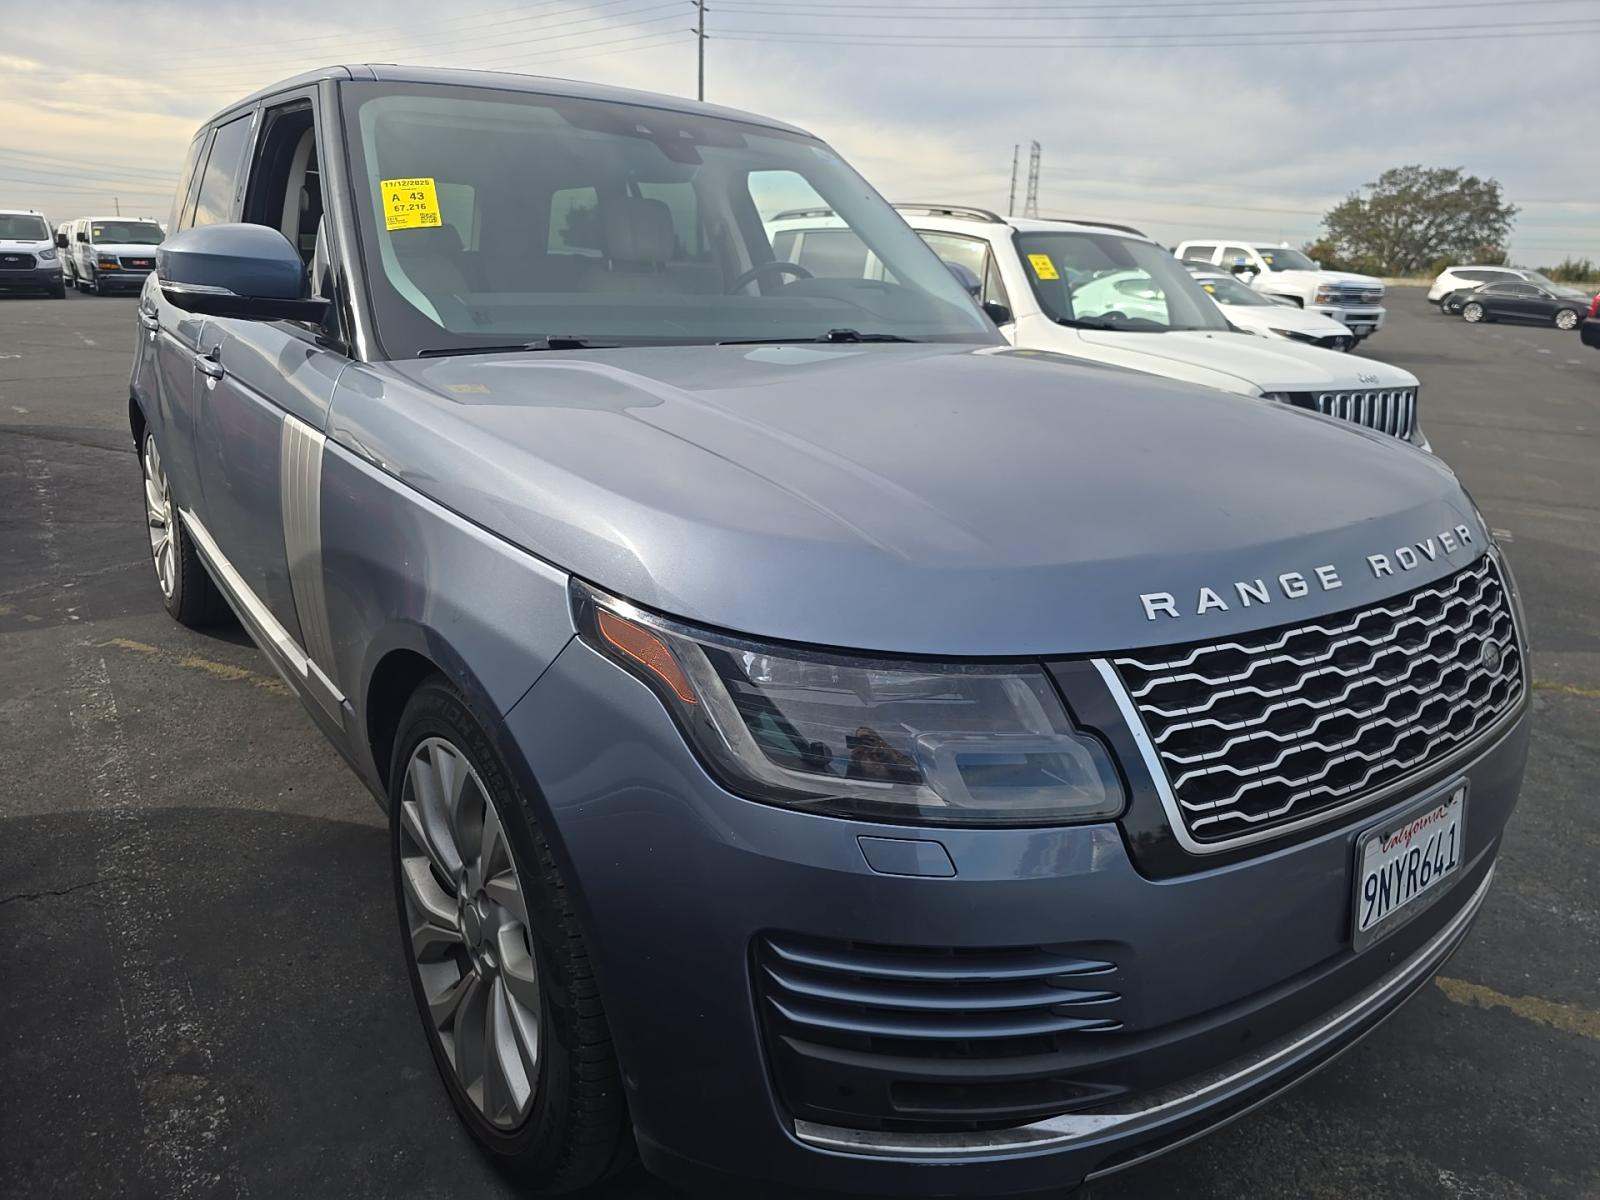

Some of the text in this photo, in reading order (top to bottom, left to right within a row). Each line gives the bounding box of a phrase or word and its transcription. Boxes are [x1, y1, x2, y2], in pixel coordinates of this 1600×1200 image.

[392, 192, 424, 202] A 43
[1139, 524, 1473, 621] RANGE ROVER
[1362, 822, 1456, 928] 9NYR641
